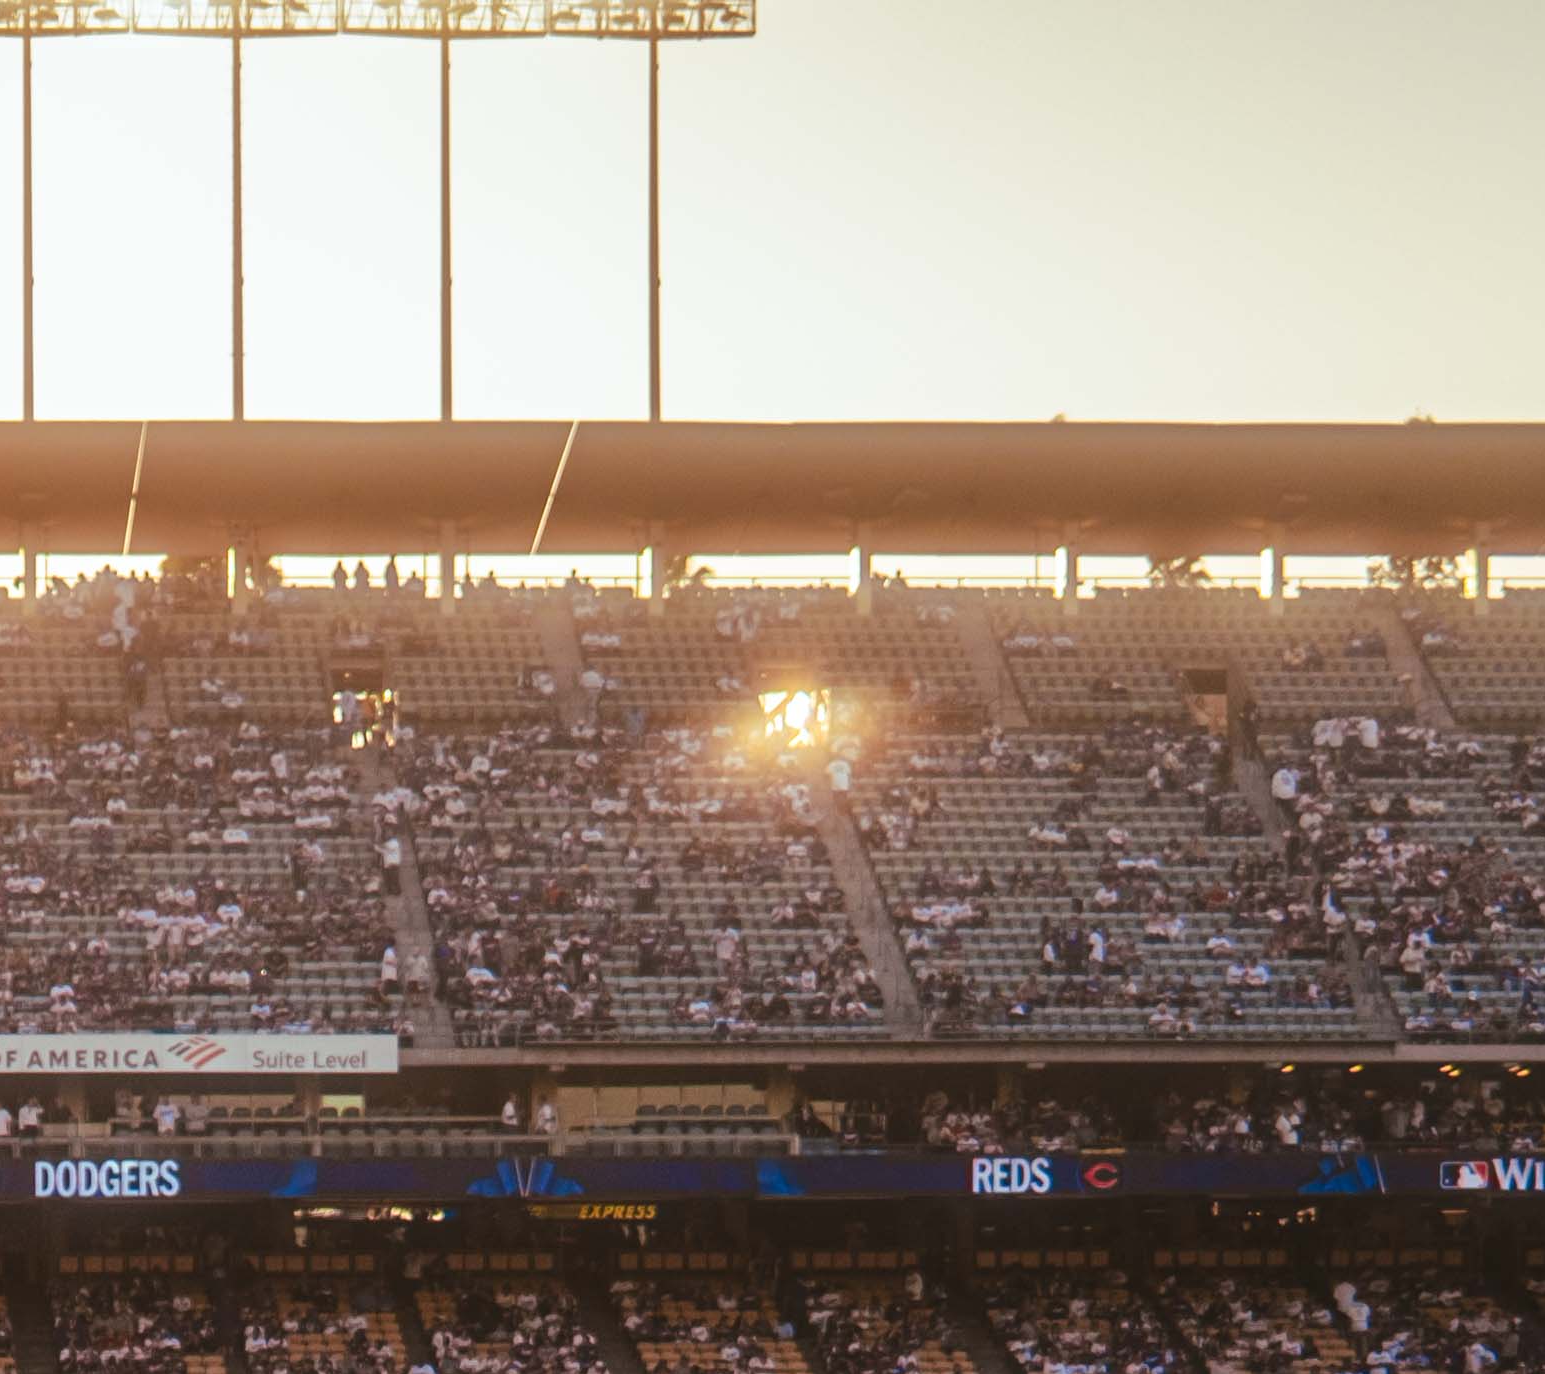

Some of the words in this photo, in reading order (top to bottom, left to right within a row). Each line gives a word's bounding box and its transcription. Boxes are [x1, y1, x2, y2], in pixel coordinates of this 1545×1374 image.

[27, 1049, 161, 1069] AMERICA
[252, 1049, 305, 1069] Suite
[313, 1049, 367, 1069] Level
[35, 1160, 181, 1198] DODGERS
[971, 1156, 1052, 1194] REDS
[578, 1204, 657, 1220] EXPRESS
